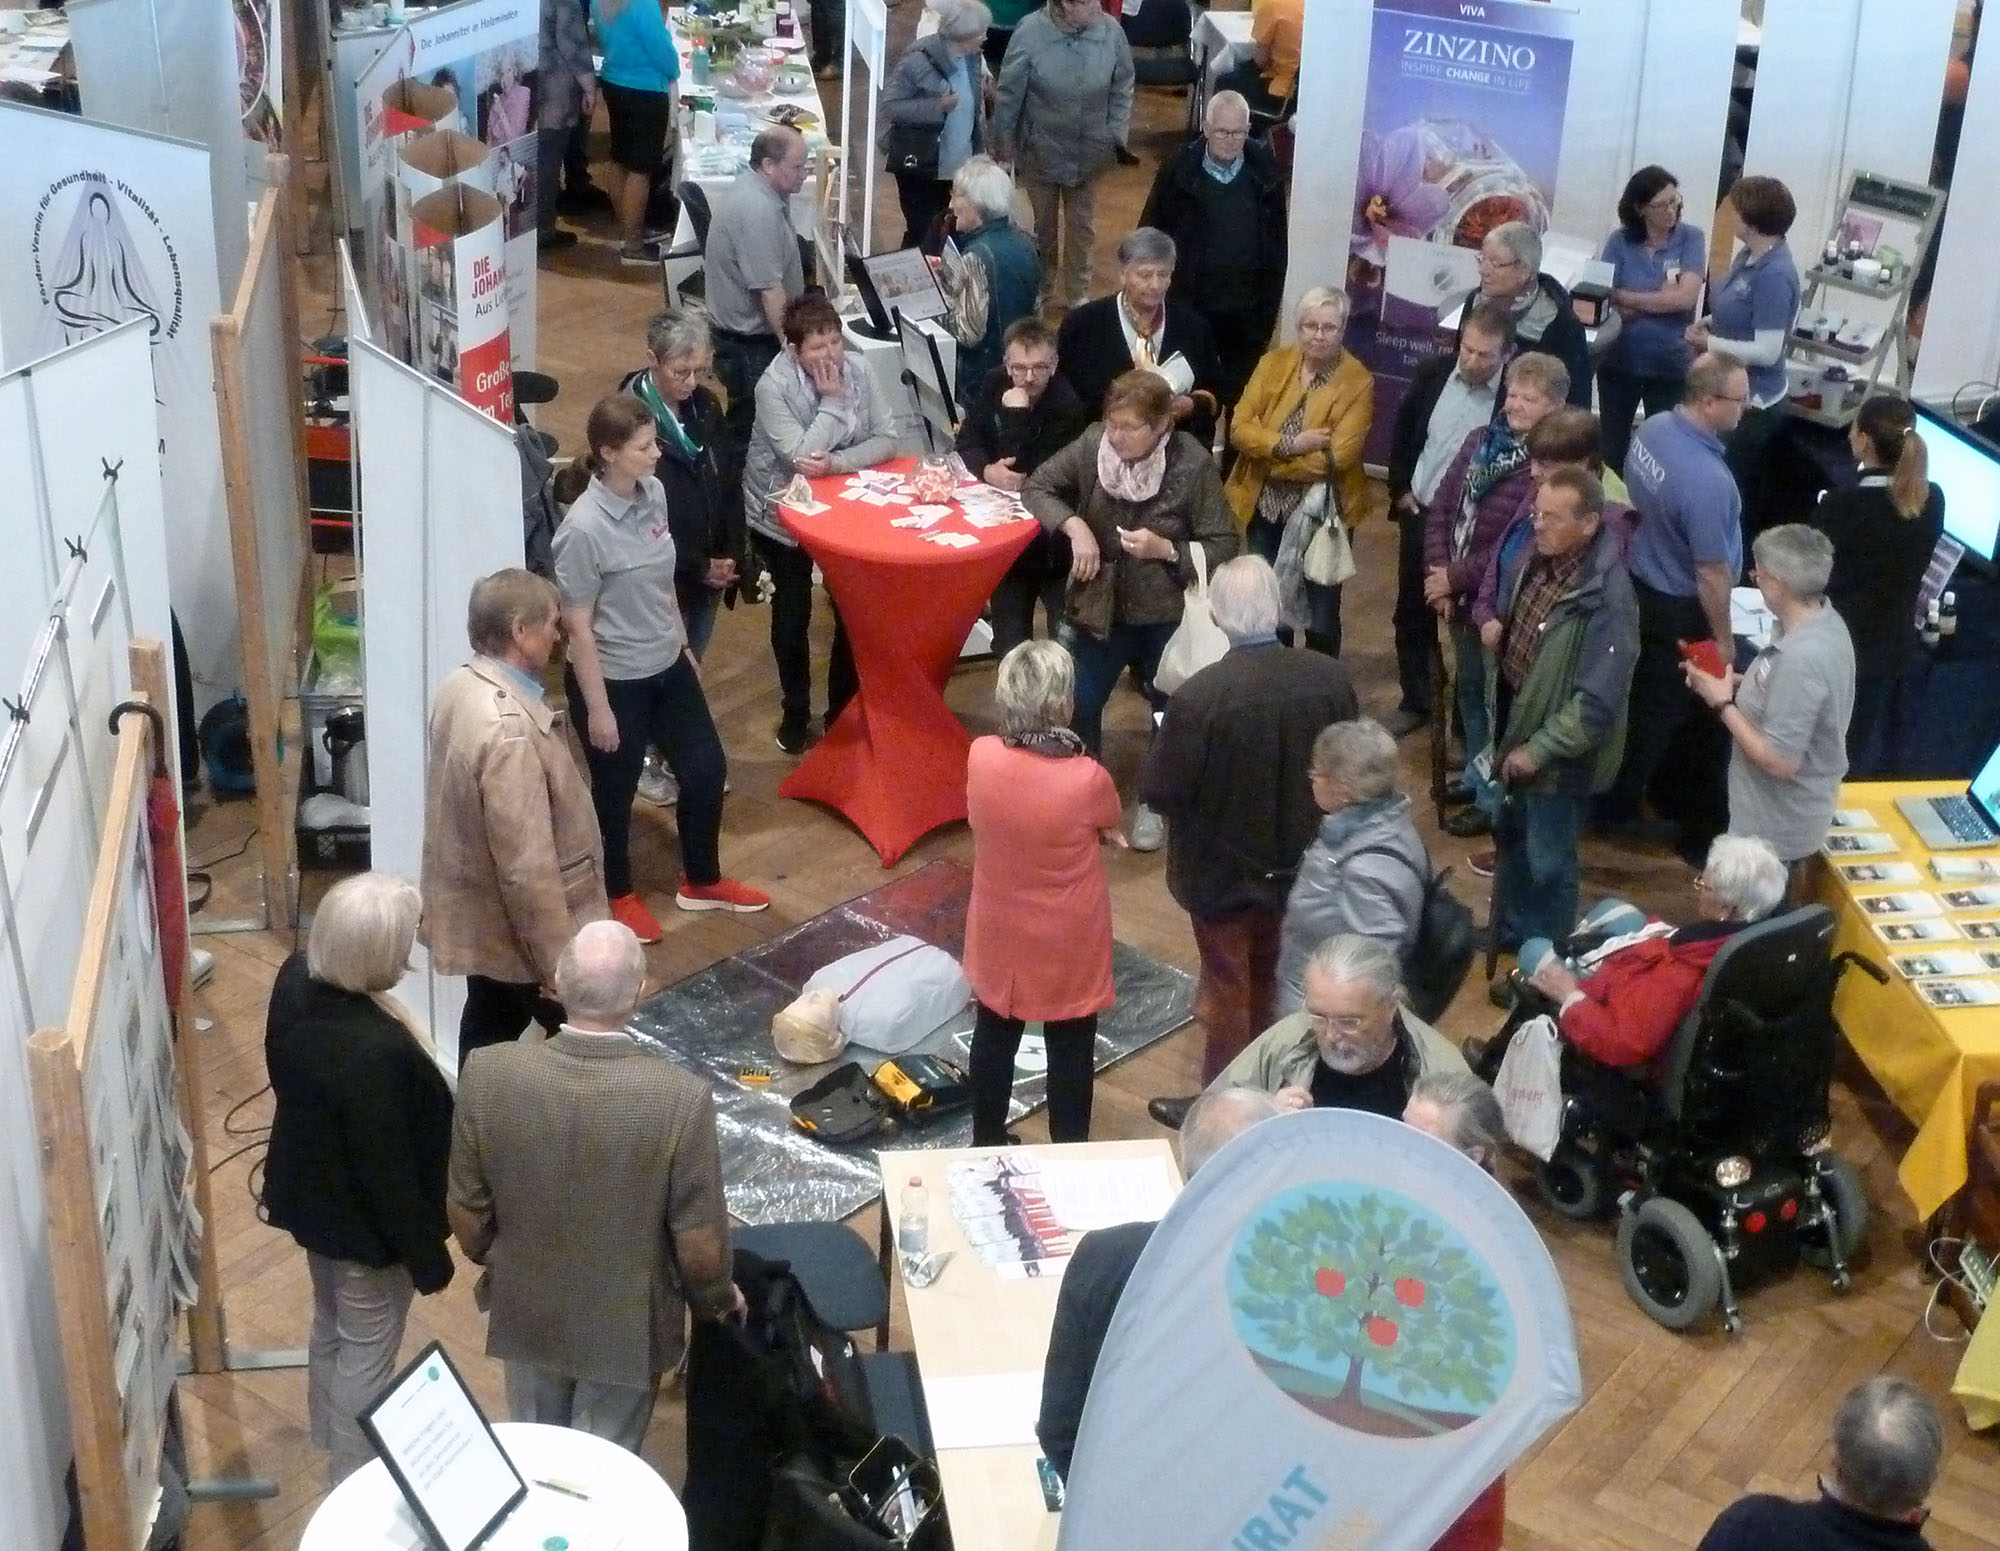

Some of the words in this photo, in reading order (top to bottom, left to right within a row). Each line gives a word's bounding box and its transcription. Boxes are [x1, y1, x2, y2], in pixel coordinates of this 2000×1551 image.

[1459, 4, 1485, 17] VIVA
[421, 38, 432, 50] Die
[434, 25, 470, 47] Johanniter
[480, 9, 518, 29] Holzminden
[1403, 29, 1536, 71] ZINZINO
[1401, 61, 1441, 75] INSPIRE
[1446, 67, 1490, 83] CHANGE
[50, 170, 107, 195] Gesundheit
[117, 180, 160, 226] Vitalität
[162, 235, 183, 340] Lebensqualität
[473, 256, 491, 279] DIE
[475, 303, 493, 318] Aus
[1231, 1464, 1328, 1551] RAT
